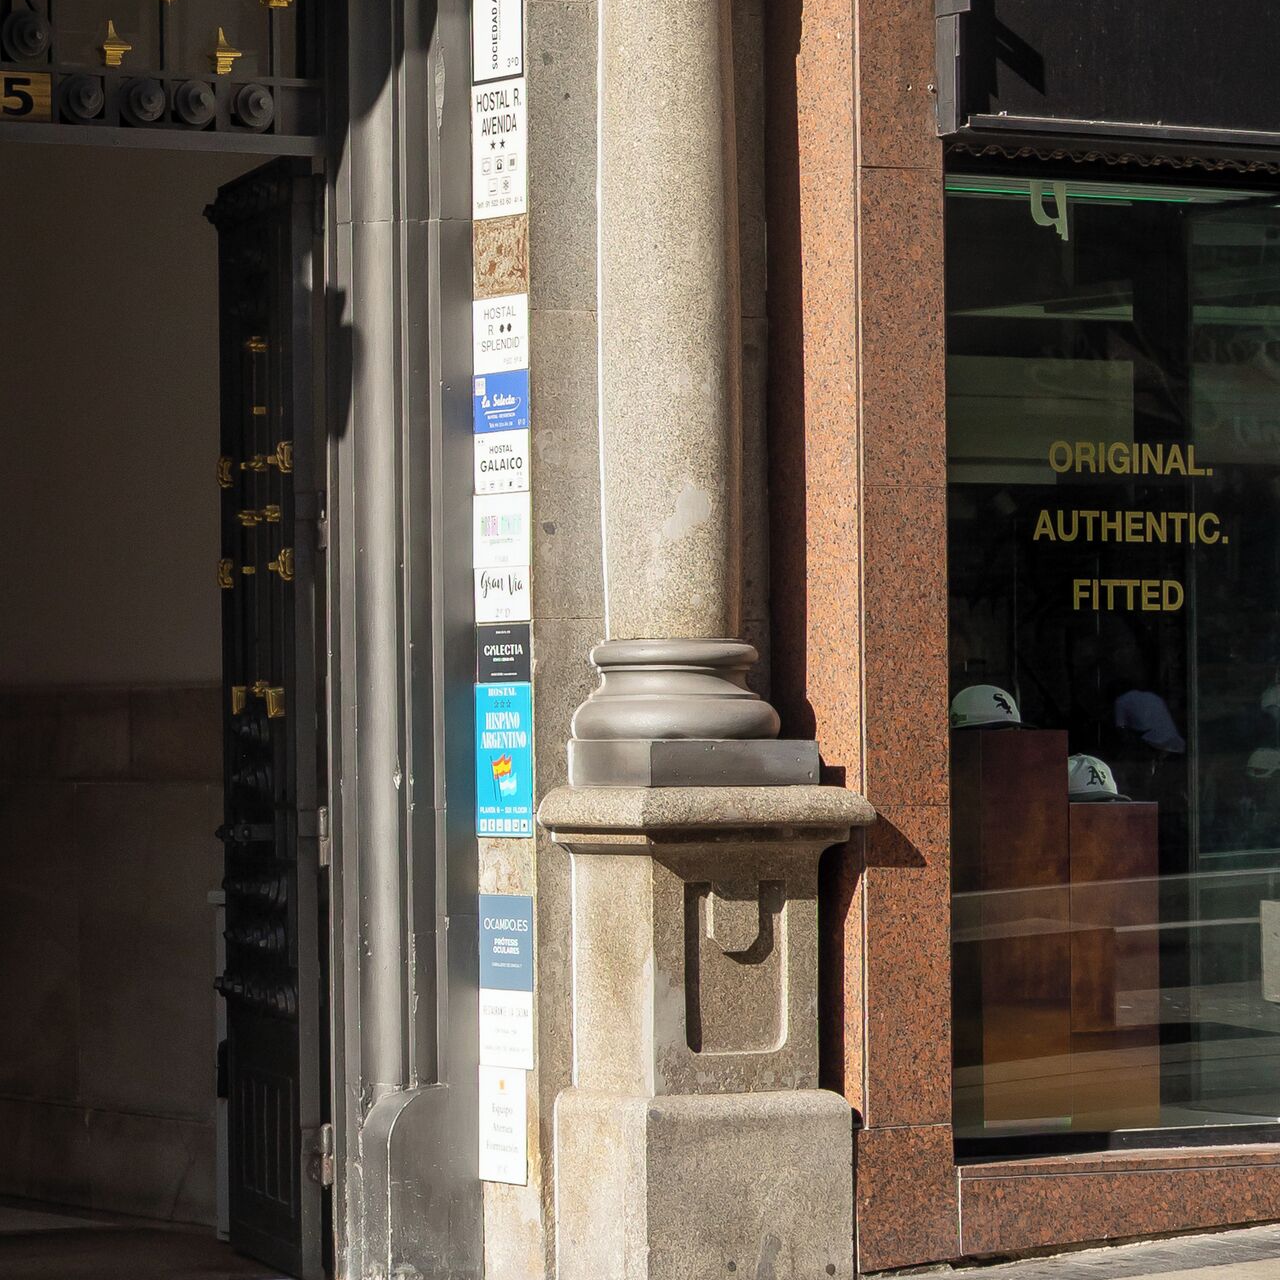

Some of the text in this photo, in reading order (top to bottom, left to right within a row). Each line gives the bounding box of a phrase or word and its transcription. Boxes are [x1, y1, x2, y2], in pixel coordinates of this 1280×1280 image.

[476, 89, 510, 112] HOSTAL
[481, 113, 517, 137] AVENIDA
[483, 305, 516, 320] HOSTAL
[488, 324, 494, 335] R
[489, 444, 512, 454] HOSTAL
[480, 457, 522, 472] GALAICO
[1048, 440, 1214, 477] ORIGINAL.
[1032, 509, 1229, 545] AUTHENTIC.
[480, 570, 503, 598] Gran
[1073, 579, 1185, 611] FITTED
[488, 687, 517, 696] HOSTAL
[485, 711, 520, 730] HISPANO
[480, 731, 527, 749] ARGENTINO
[493, 946, 520, 955] OCULARES
[494, 937, 519, 947] PRÓTESIS
